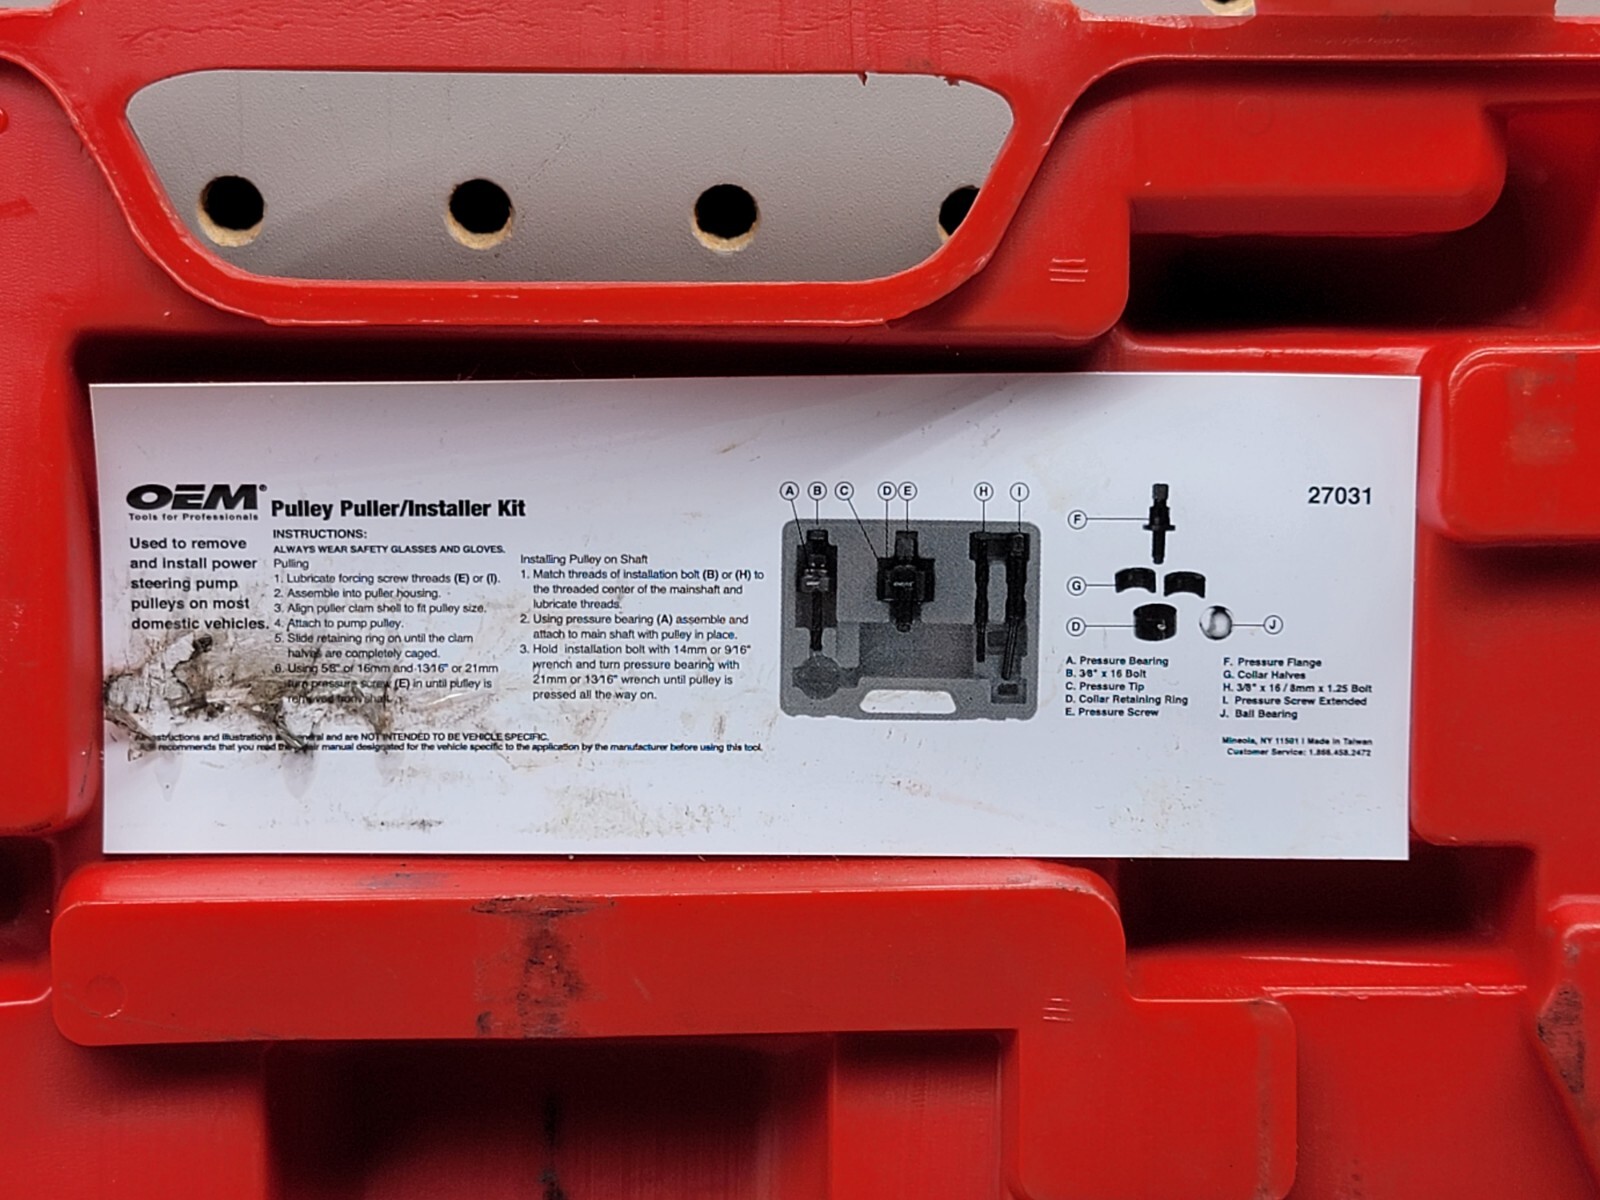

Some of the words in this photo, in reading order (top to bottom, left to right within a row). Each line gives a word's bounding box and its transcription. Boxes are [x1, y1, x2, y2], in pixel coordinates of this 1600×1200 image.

[1308, 486, 1371, 505] 27031
[271, 500, 334, 520] Pulley
[340, 499, 492, 517] Puller/Installer
[498, 499, 526, 517] Kit
[273, 529, 367, 539] INSTRUCTIONS:
[130, 537, 167, 549] Used
[172, 538, 186, 549] to
[192, 540, 247, 549] remove
[274, 545, 315, 553] ALWAYS
[318, 545, 347, 553] WEAR
[350, 545, 388, 553] SAFETY
[391, 545, 437, 553] GLASSES
[440, 545, 460, 553] AND
[463, 545, 505, 553] GLOVES.
[130, 557, 157, 569] and
[162, 557, 207, 569] install
[212, 560, 258, 572] power
[274, 558, 309, 570] Pulling
[521, 554, 565, 566] Installing
[570, 554, 601, 566] Pulley
[605, 556, 617, 564] on
[621, 554, 647, 564] Shaft
[275, 574, 283, 583] 1.
[287, 573, 335, 583] Lubricate
[339, 573, 374, 585] forcing
[412, 574, 451, 583] threads
[454, 573, 469, 585] (E)
[521, 569, 529, 579] 1.
[533, 569, 565, 579] Match
[568, 569, 607, 579] threads
[610, 569, 620, 579] of
[623, 569, 678, 579] installation
[681, 570, 700, 579] bolt
[703, 569, 719, 581] (B)
[735, 570, 751, 581] (H)
[754, 570, 764, 579] to
[130, 577, 191, 592] steering
[196, 580, 238, 592] pump
[533, 584, 549, 594] the
[553, 584, 599, 594] threaded
[602, 585, 634, 594] center
[637, 584, 647, 594] of
[650, 585, 666, 594] the
[670, 584, 720, 594] mainshaft
[723, 585, 742, 594] and
[274, 589, 283, 598] 2.
[287, 588, 339, 598] Assemble
[343, 589, 362, 598] into
[365, 588, 394, 600] puller
[396, 588, 441, 601] housing.
[131, 597, 184, 612] pulleys
[190, 600, 207, 609] on
[213, 598, 249, 609] most
[274, 603, 284, 613] 3.
[287, 603, 314, 615] Align
[317, 604, 346, 616] puller
[348, 604, 374, 613] clam
[377, 603, 401, 613] shell
[404, 604, 414, 613] to
[417, 603, 426, 613] fit
[429, 603, 460, 615] pulley
[463, 604, 488, 613] size.
[534, 599, 577, 609] lubricate
[581, 599, 622, 609] threads.
[132, 617, 199, 629] domestic
[205, 617, 269, 630] vehicles.
[274, 619, 283, 627] 4.
[287, 618, 321, 628] Attach
[324, 619, 334, 627] to
[337, 620, 367, 631] pump
[370, 619, 404, 630] pulley.
[520, 613, 529, 623] 2.
[534, 614, 563, 626] Using
[566, 616, 611, 627] pressure
[615, 614, 653, 626] bearing
[657, 614, 672, 626] (A)
[676, 615, 725, 625] assemble
[729, 615, 748, 624] and
[1066, 656, 1076, 664] A.
[1080, 656, 1126, 665] Pressure
[1129, 656, 1168, 667] Bearing
[1223, 657, 1233, 666] F.
[1238, 657, 1284, 666] Pressure
[1287, 658, 1322, 668] Flange
[1066, 669, 1076, 677] B.
[1111, 669, 1122, 678] 16
[1125, 669, 1146, 678] Bolt
[1223, 670, 1234, 679] G.
[1237, 670, 1268, 679] Collar
[1271, 671, 1306, 679] Halves
[1066, 681, 1076, 690] C.
[1080, 682, 1125, 690] Pressure
[1128, 682, 1144, 693] Tip
[1223, 683, 1233, 692] H.
[1270, 683, 1281, 692] 16
[1290, 684, 1315, 692] 8mm
[1351, 684, 1372, 693] Bolt
[1065, 694, 1075, 703] D.
[1079, 694, 1109, 703] Collar
[1113, 695, 1161, 706] Retaining
[1165, 695, 1188, 706] Ring
[1235, 696, 1281, 705] Pressure
[1284, 696, 1316, 705] Screw
[1319, 696, 1367, 705] Extended
[1065, 707, 1075, 716] E.
[1078, 707, 1124, 716] Pressure
[1127, 707, 1159, 716] Screw
[1219, 709, 1229, 718] J.
[1235, 709, 1255, 718] Ball
[1258, 709, 1298, 720] Bearing
[1260, 737, 1273, 745] NY
[532, 743, 579, 752] application
[581, 743, 593, 753] by
[595, 743, 608, 751] the
[610, 743, 668, 751] manufacturer
[670, 743, 698, 751] before
[700, 743, 724, 753] using
[726, 743, 742, 751] this
